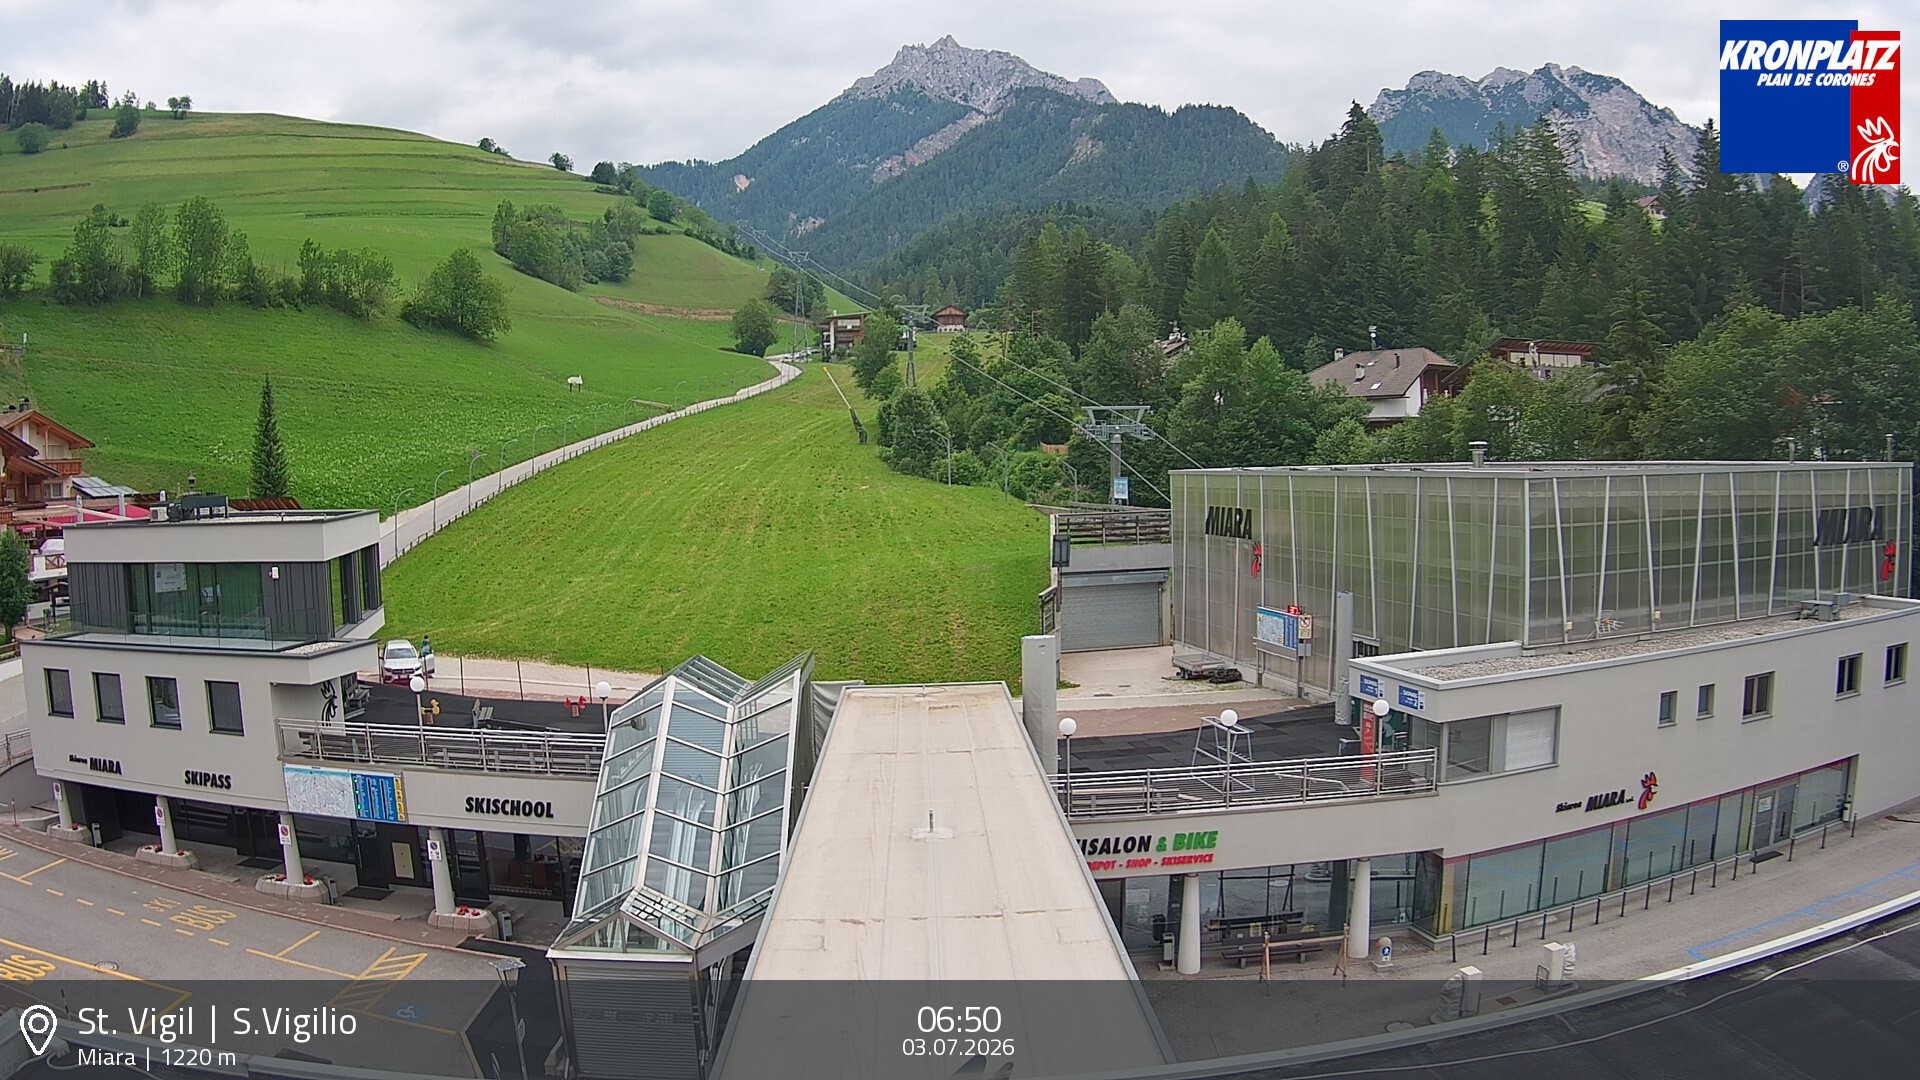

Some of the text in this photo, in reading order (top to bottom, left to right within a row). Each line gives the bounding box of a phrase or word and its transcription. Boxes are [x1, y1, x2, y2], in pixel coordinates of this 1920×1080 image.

[1205, 506, 1252, 540] MIARA
[90, 757, 122, 775] MIARA
[184, 770, 232, 790] SKIPASS
[465, 796, 554, 819] SKISCHOOL
[1585, 789, 1626, 812] MIARA
[1077, 831, 1218, 856] ISALON & BIKE
[1126, 858, 1152, 869] SHOP
[1161, 853, 1214, 866] SKISERVICE
[143, 897, 182, 913] SKI
[169, 904, 238, 931] BUS
